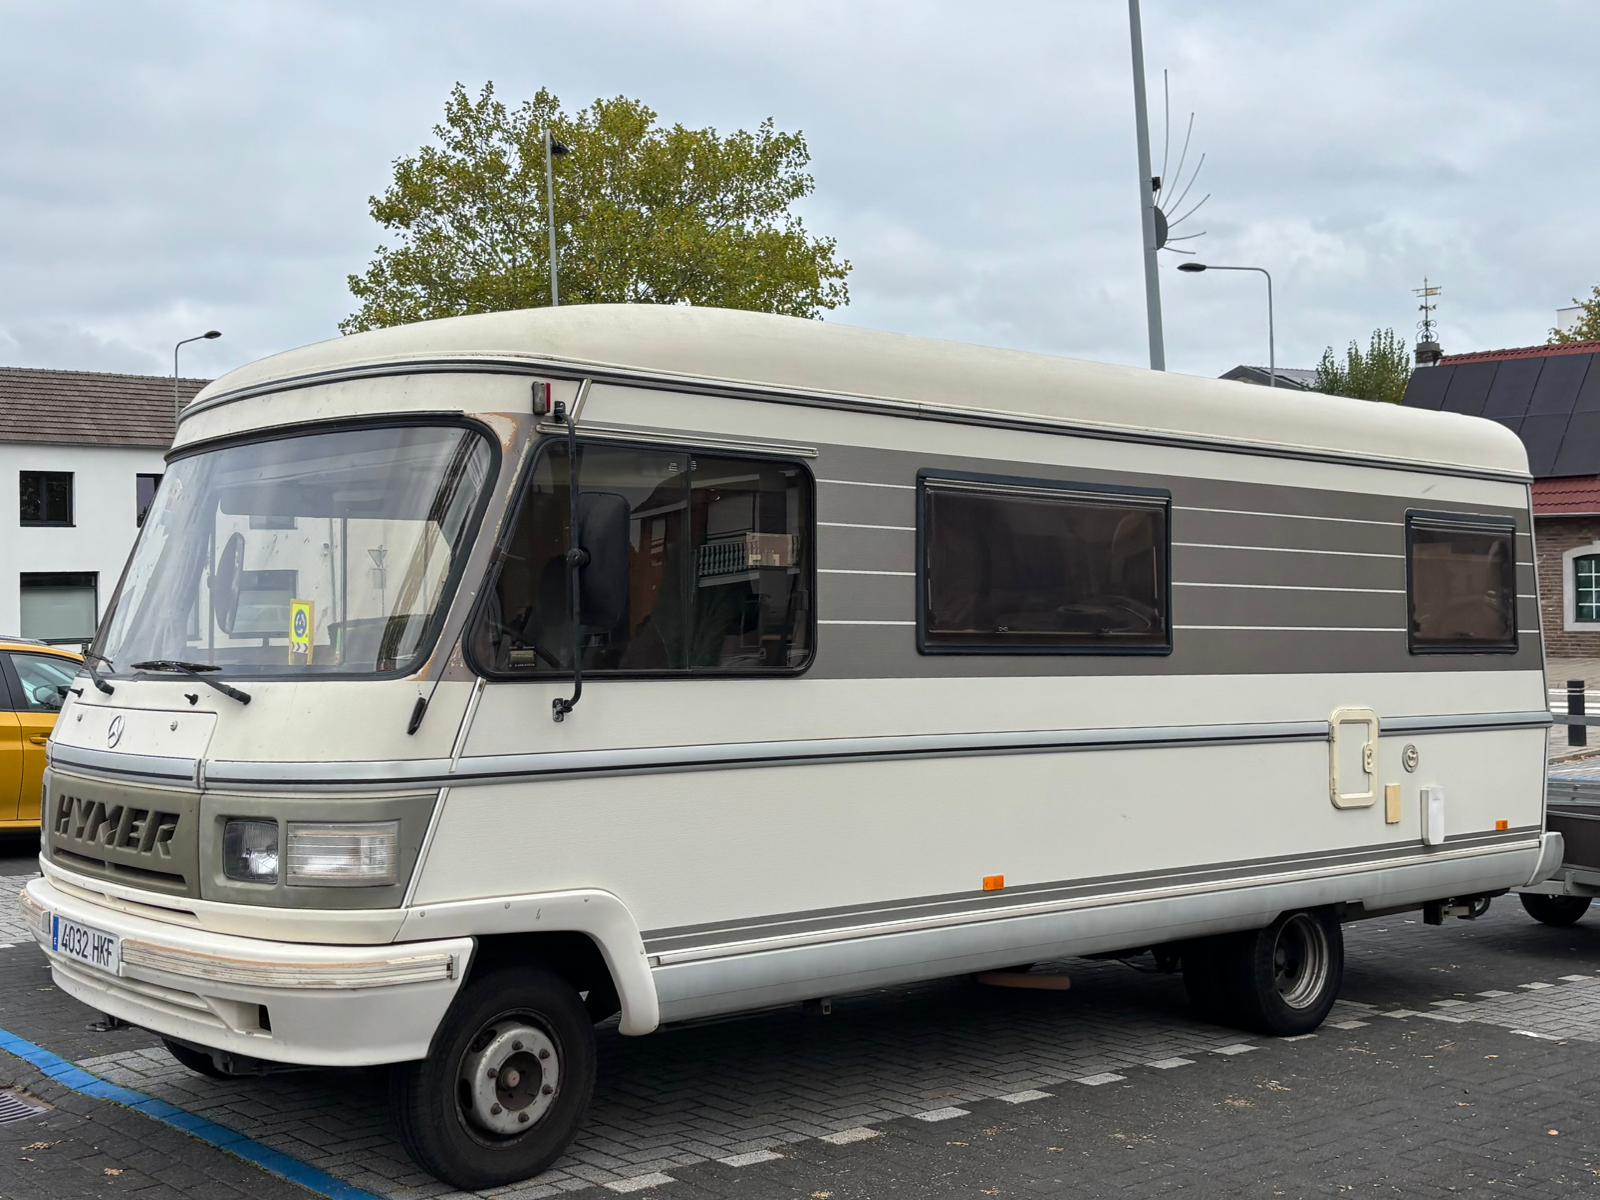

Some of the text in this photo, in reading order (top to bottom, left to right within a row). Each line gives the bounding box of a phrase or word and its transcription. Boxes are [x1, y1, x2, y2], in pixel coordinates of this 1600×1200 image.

[54, 794, 180, 859] HYMER
[61, 923, 114, 967] 4032 HKF
